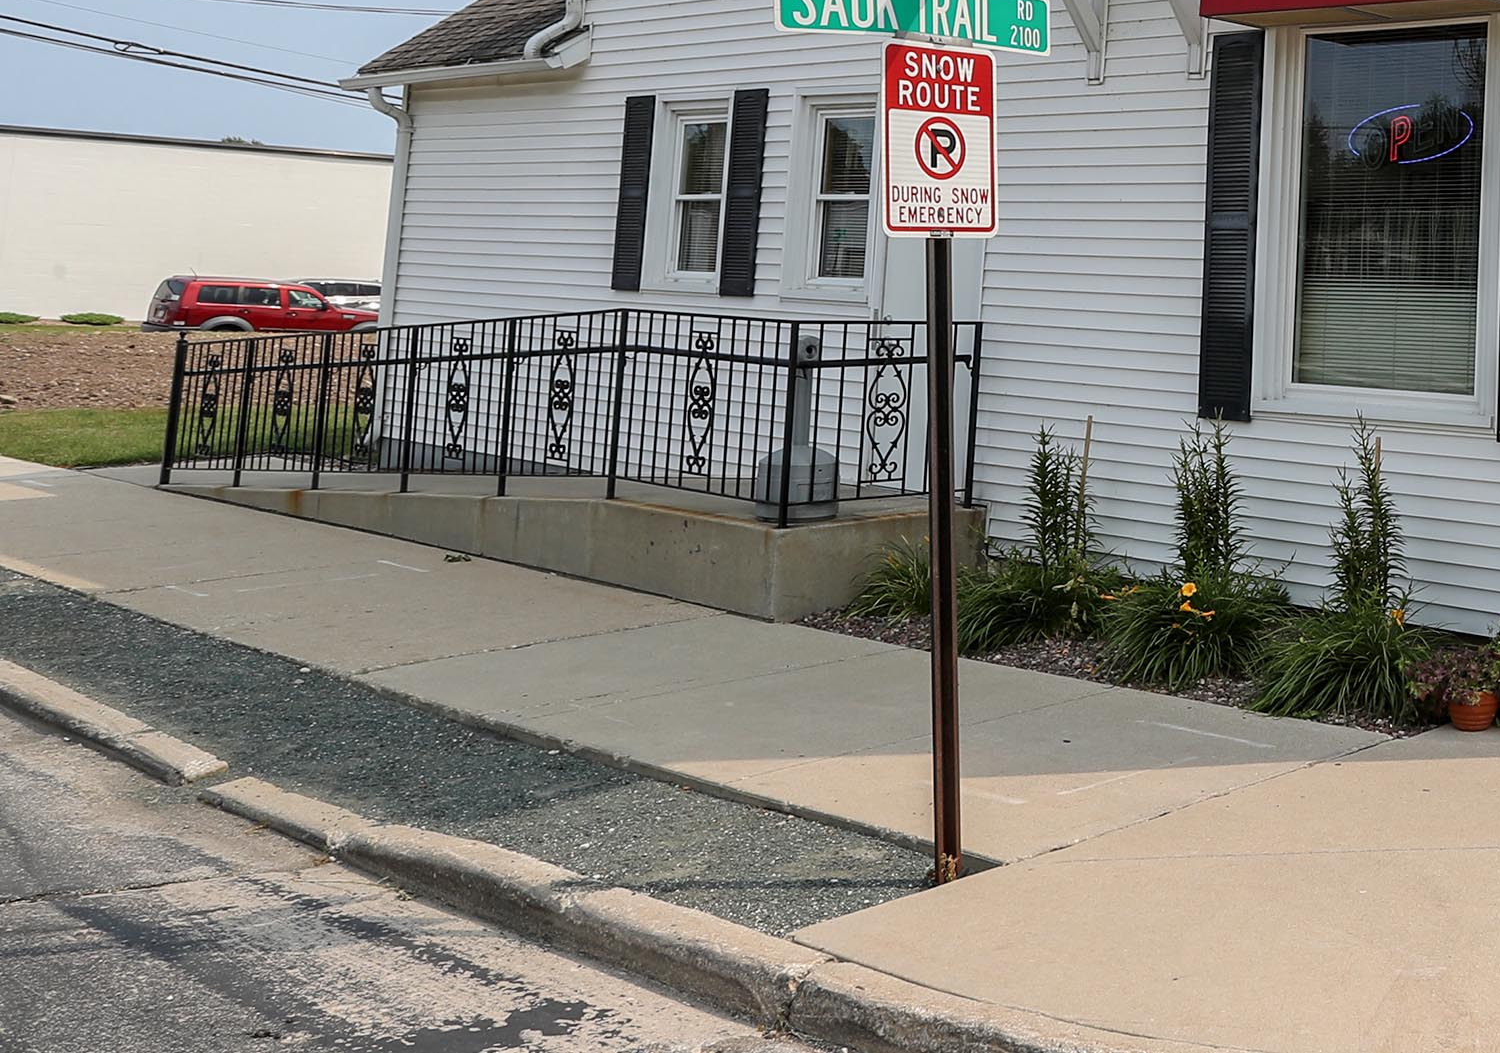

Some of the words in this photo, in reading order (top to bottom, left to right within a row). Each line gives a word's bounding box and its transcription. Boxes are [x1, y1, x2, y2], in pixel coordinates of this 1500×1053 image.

[1017, 0, 1033, 21] RD
[1010, 25, 1041, 48] 2100
[905, 51, 974, 82] SNOW
[899, 79, 981, 111] ROUTE
[892, 185, 941, 204] DURING
[952, 187, 989, 204] SNOW
[899, 206, 982, 224] EMERGENCY
